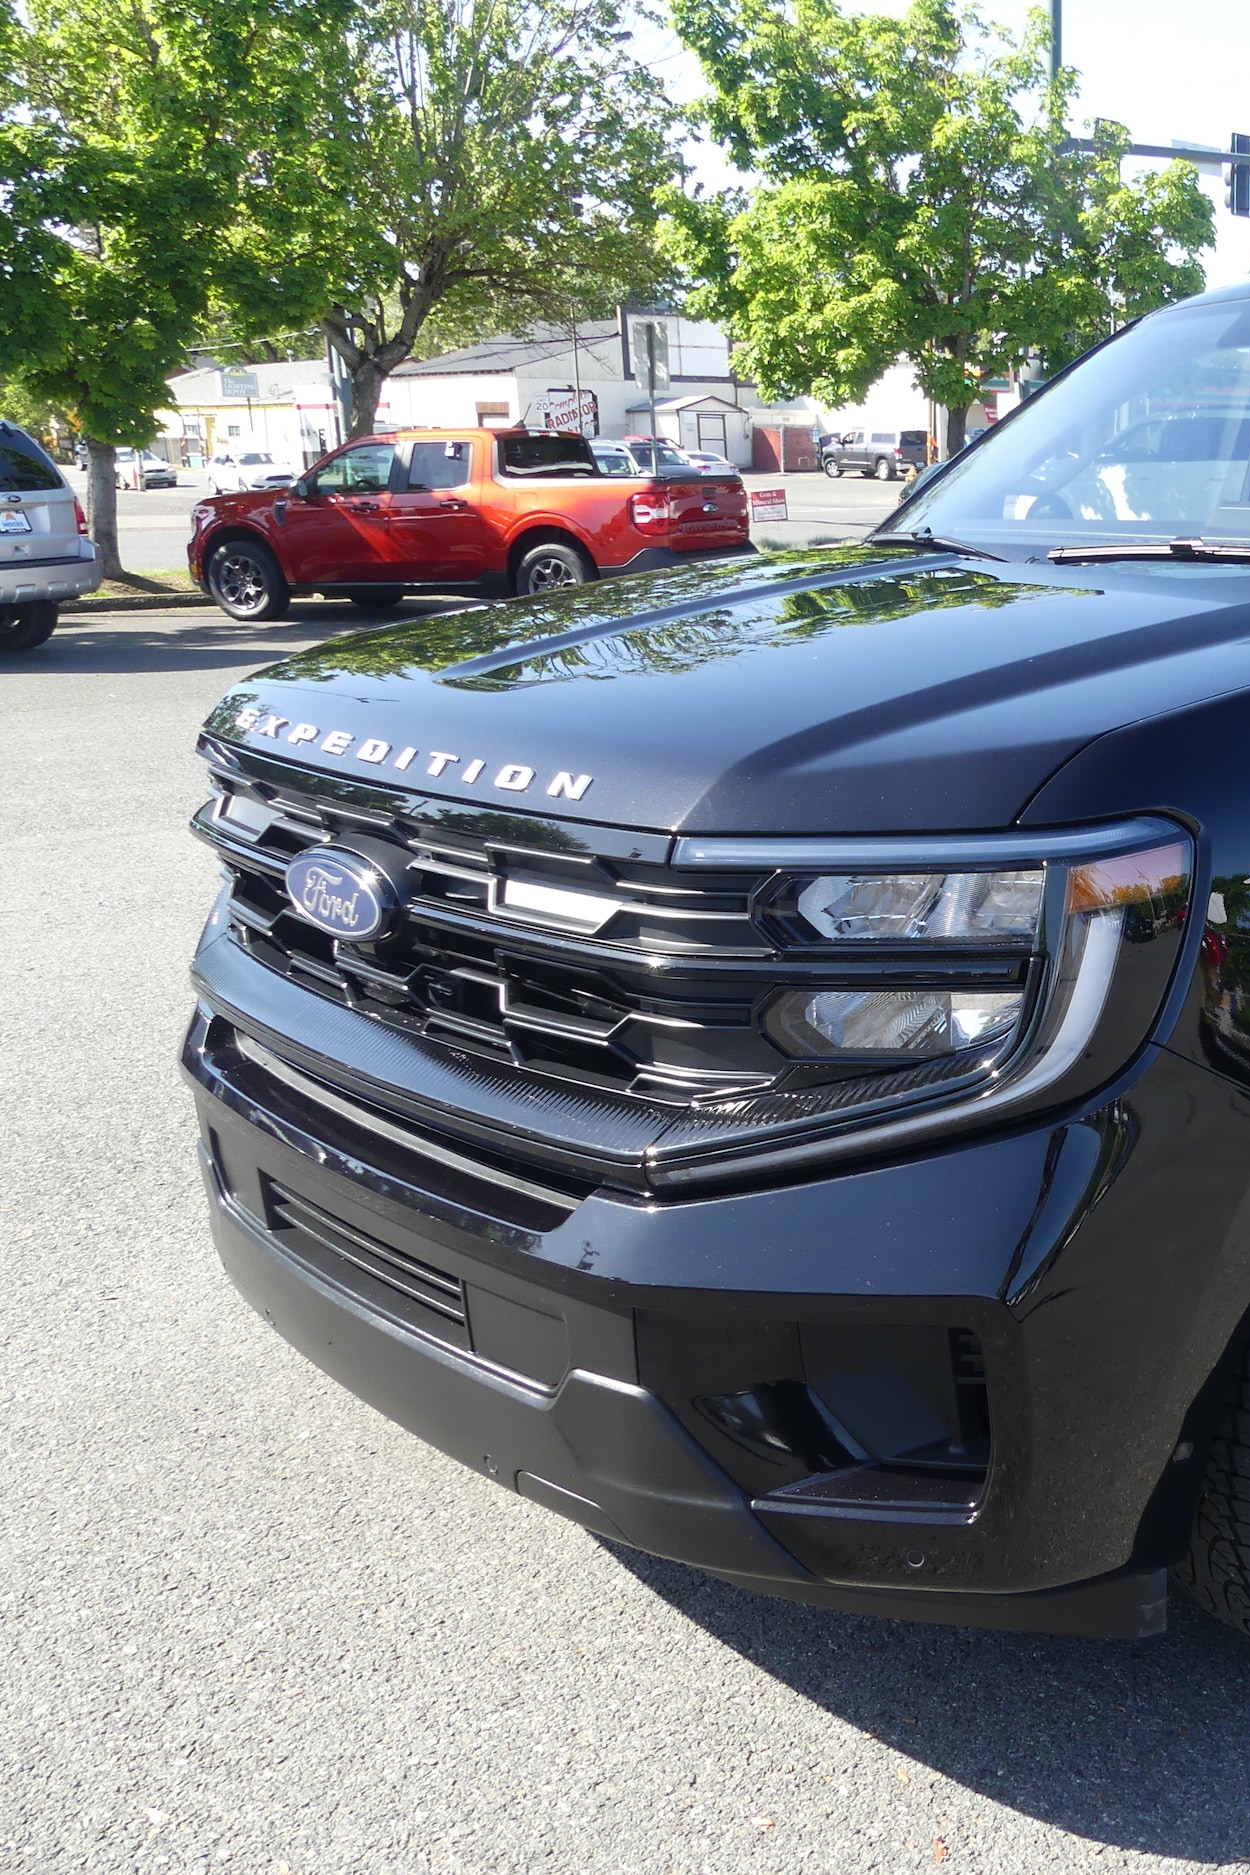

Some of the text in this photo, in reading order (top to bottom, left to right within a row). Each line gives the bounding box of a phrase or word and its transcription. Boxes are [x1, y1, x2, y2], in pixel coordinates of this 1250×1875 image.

[536, 402, 549, 411] 20
[235, 708, 594, 800] EXPEDITION
[302, 865, 360, 929] Ford
